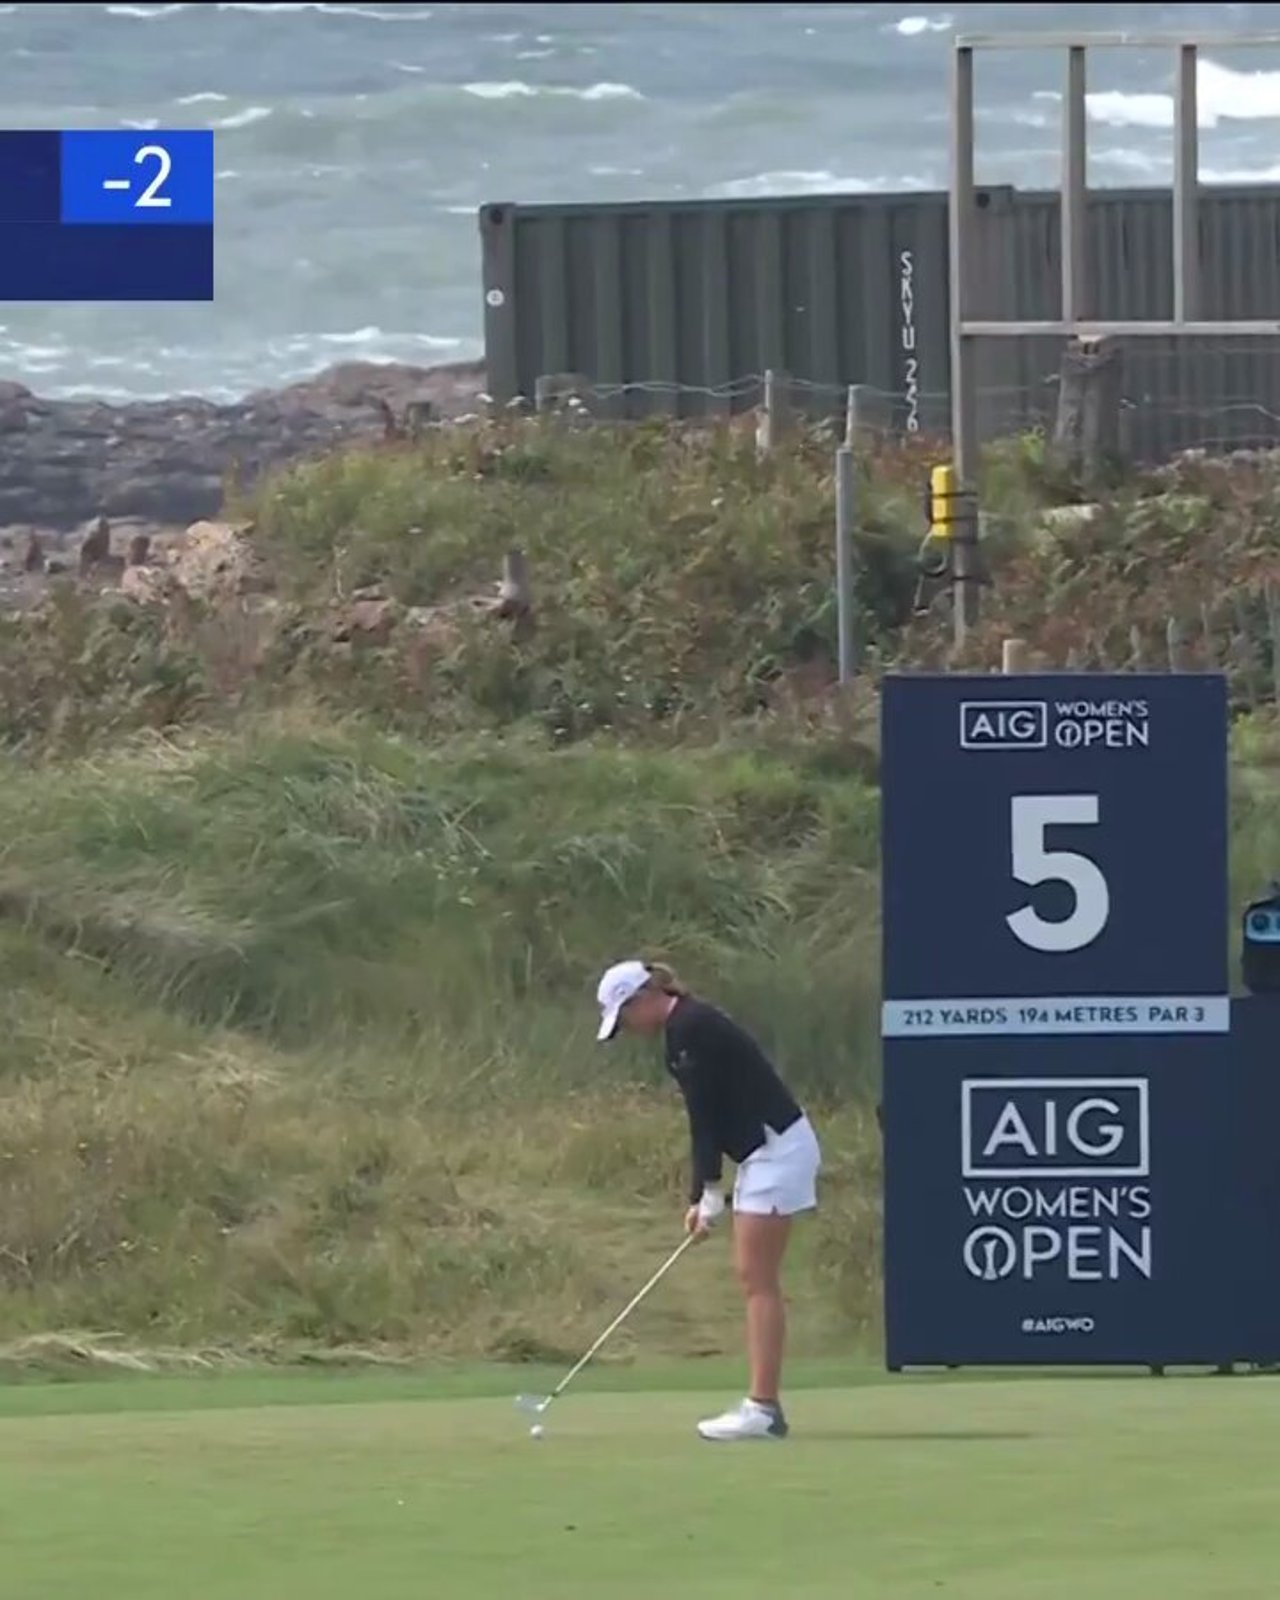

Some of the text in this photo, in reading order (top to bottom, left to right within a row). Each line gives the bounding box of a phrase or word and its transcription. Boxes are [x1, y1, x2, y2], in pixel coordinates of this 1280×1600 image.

[901, 251, 915, 350] SKYU
[970, 710, 1036, 739] AIG
[1055, 700, 1149, 717] WOMEN'S
[1055, 719, 1149, 747] OPEN
[1005, 795, 1110, 951] 5
[904, 1009, 933, 1025] 212
[940, 1008, 1008, 1025] YARDS
[1019, 1007, 1049, 1023] 194
[1055, 1007, 1138, 1023] METRES
[1149, 1006, 1189, 1022] PAR
[982, 1098, 1124, 1156] AIG
[963, 1186, 1152, 1218] WOMEN'S
[963, 1226, 1152, 1280] OPEN
